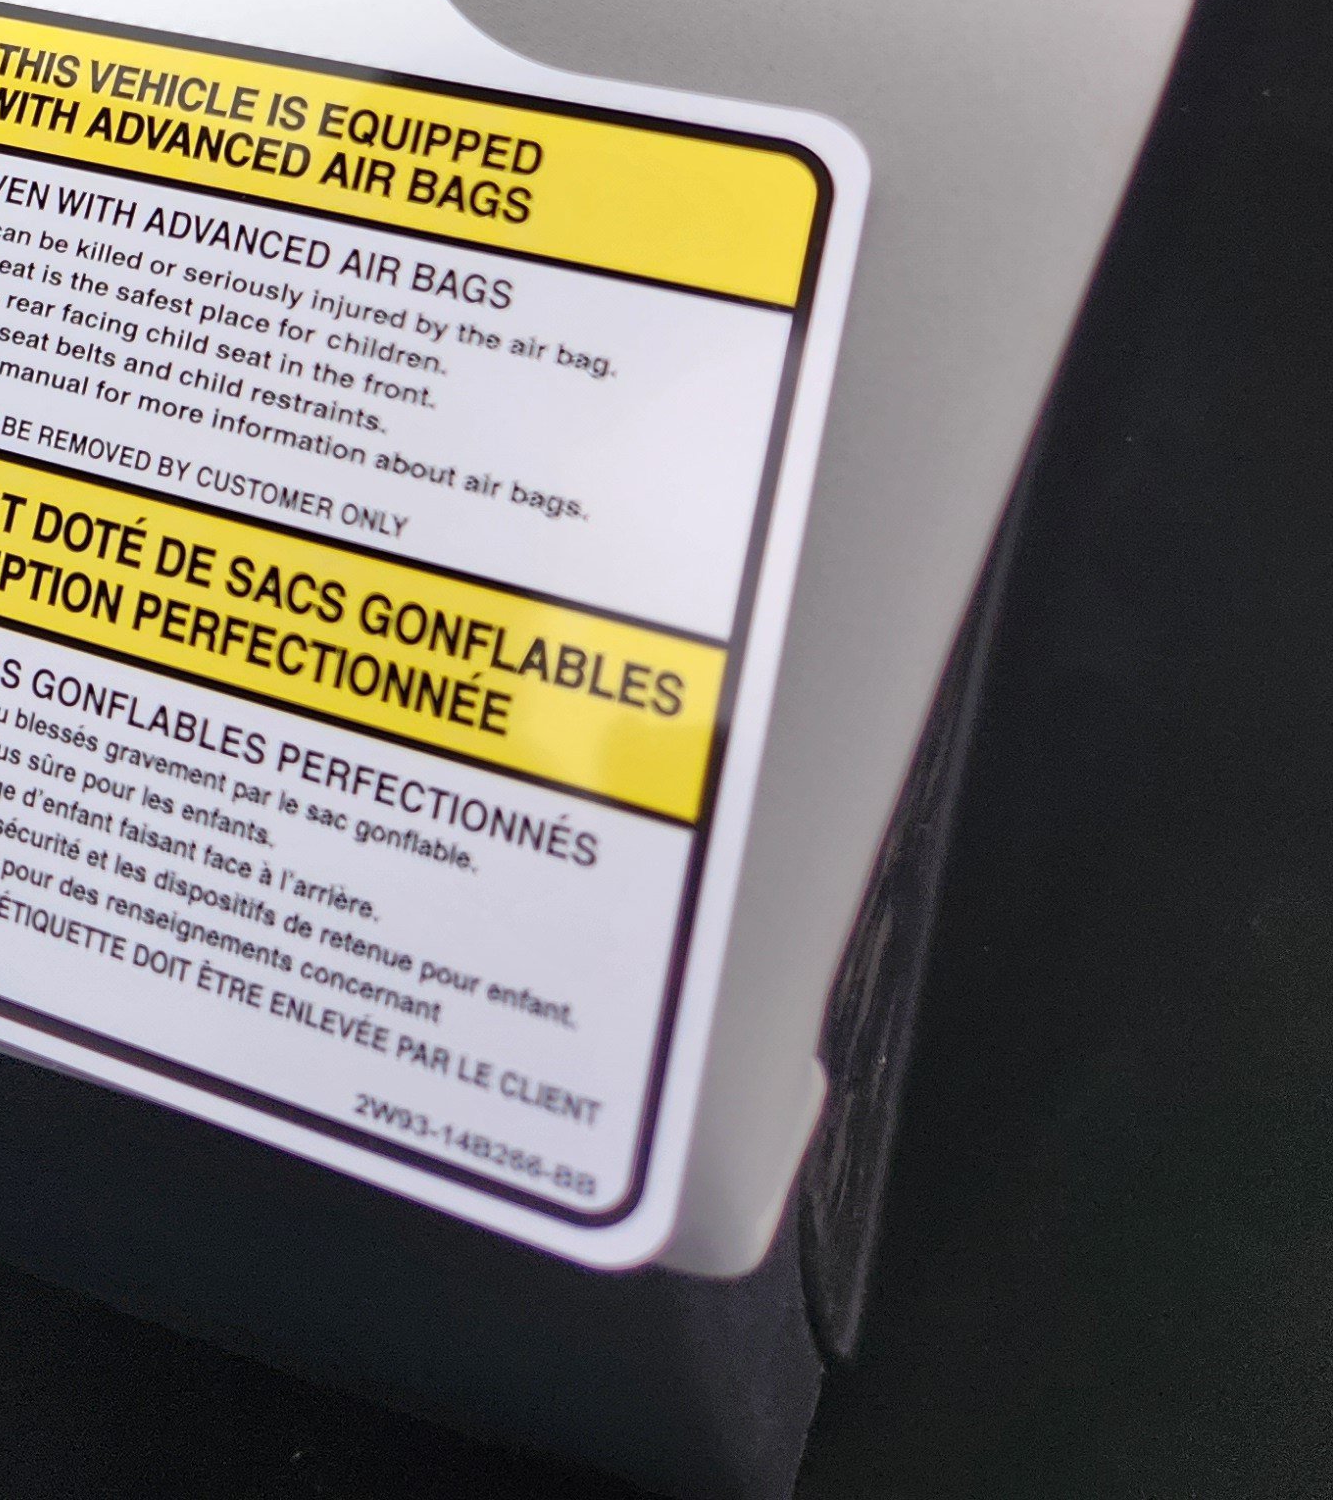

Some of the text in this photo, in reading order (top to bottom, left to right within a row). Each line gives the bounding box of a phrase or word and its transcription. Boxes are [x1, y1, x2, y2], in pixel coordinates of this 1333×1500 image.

[82, 105, 313, 181] ADVANCED
[316, 150, 398, 200] AIR
[404, 165, 535, 226] BAGS
[89, 57, 262, 125] VEHICLE
[264, 91, 310, 133] IS
[316, 101, 547, 177] EQUIPPED
[37, 228, 71, 255] be
[74, 236, 145, 272] killed
[148, 258, 179, 279] or
[181, 265, 306, 312] seriously
[309, 287, 410, 331] injured
[413, 311, 452, 345] by
[456, 321, 503, 352] the
[508, 335, 550, 362] air
[554, 342, 617, 382] bag.
[56, 185, 139, 231] WITH
[141, 205, 332, 271] ADVANCED
[337, 247, 403, 289] AIR
[409, 260, 515, 311] BAGS
[4, 293, 58, 320] rear
[60, 301, 140, 345] facing
[144, 324, 211, 356] child
[213, 342, 273, 373] seat
[277, 351, 306, 379] in
[311, 360, 357, 391] the
[362, 371, 437, 411] front.
[40, 262, 64, 288] is
[69, 270, 111, 298] the
[114, 284, 195, 319] safest
[197, 302, 272, 335] place
[277, 316, 318, 346] for
[325, 330, 448, 377] children.
[53, 334, 118, 369] belts
[121, 355, 175, 383] and
[177, 366, 245, 401] child
[248, 385, 388, 436] restraints.
[0, 414, 35, 444] BE
[35, 423, 153, 473] REMOVED
[155, 454, 193, 484] BY
[195, 464, 336, 523] CUSTOMER
[339, 501, 411, 540] ONLY
[94, 378, 133, 407] for
[136, 393, 205, 426] more
[210, 406, 368, 467] information
[372, 450, 458, 490] about
[462, 472, 504, 500] air
[508, 479, 589, 522] bags.
[30, 500, 149, 571] DOTÉ
[152, 533, 219, 591] DE
[223, 553, 349, 626] SACS
[357, 590, 687, 719] GONFLABLES
[130, 588, 515, 739] PERFECTIONNÉE
[12, 705, 100, 754] blessés
[102, 740, 229, 796] gravement
[229, 780, 275, 809] par
[276, 788, 301, 817] le
[303, 802, 350, 833] sac
[352, 818, 480, 875] gonflable.
[25, 751, 79, 785] sûre
[80, 770, 138, 803] pour
[140, 783, 176, 816] les
[180, 802, 276, 850] enfants.
[30, 666, 268, 767] GONFLABLES
[275, 740, 600, 869] PERFECTIONNÉS
[20, 785, 115, 836] d'enfant
[117, 815, 199, 864] faisant
[201, 843, 254, 881] face
[256, 859, 275, 889] à
[0, 857, 56, 891] pour
[57, 874, 101, 909] des
[104, 893, 295, 974] renseignements
[298, 960, 443, 1026] concernant
[85, 848, 110, 872] et
[112, 851, 149, 885] les
[152, 867, 278, 929] dispositifs
[281, 911, 315, 941] de
[318, 926, 415, 974] retenue
[417, 959, 483, 996] pour
[485, 981, 575, 1029] enfant.
[131, 941, 194, 984] DOIT
[195, 958, 266, 1011] ÊTRE
[267, 989, 392, 1055] ENLEVÉE
[394, 1033, 454, 1077] PAR
[455, 1054, 494, 1092] LE
[498, 1069, 603, 1127] CLIENT
